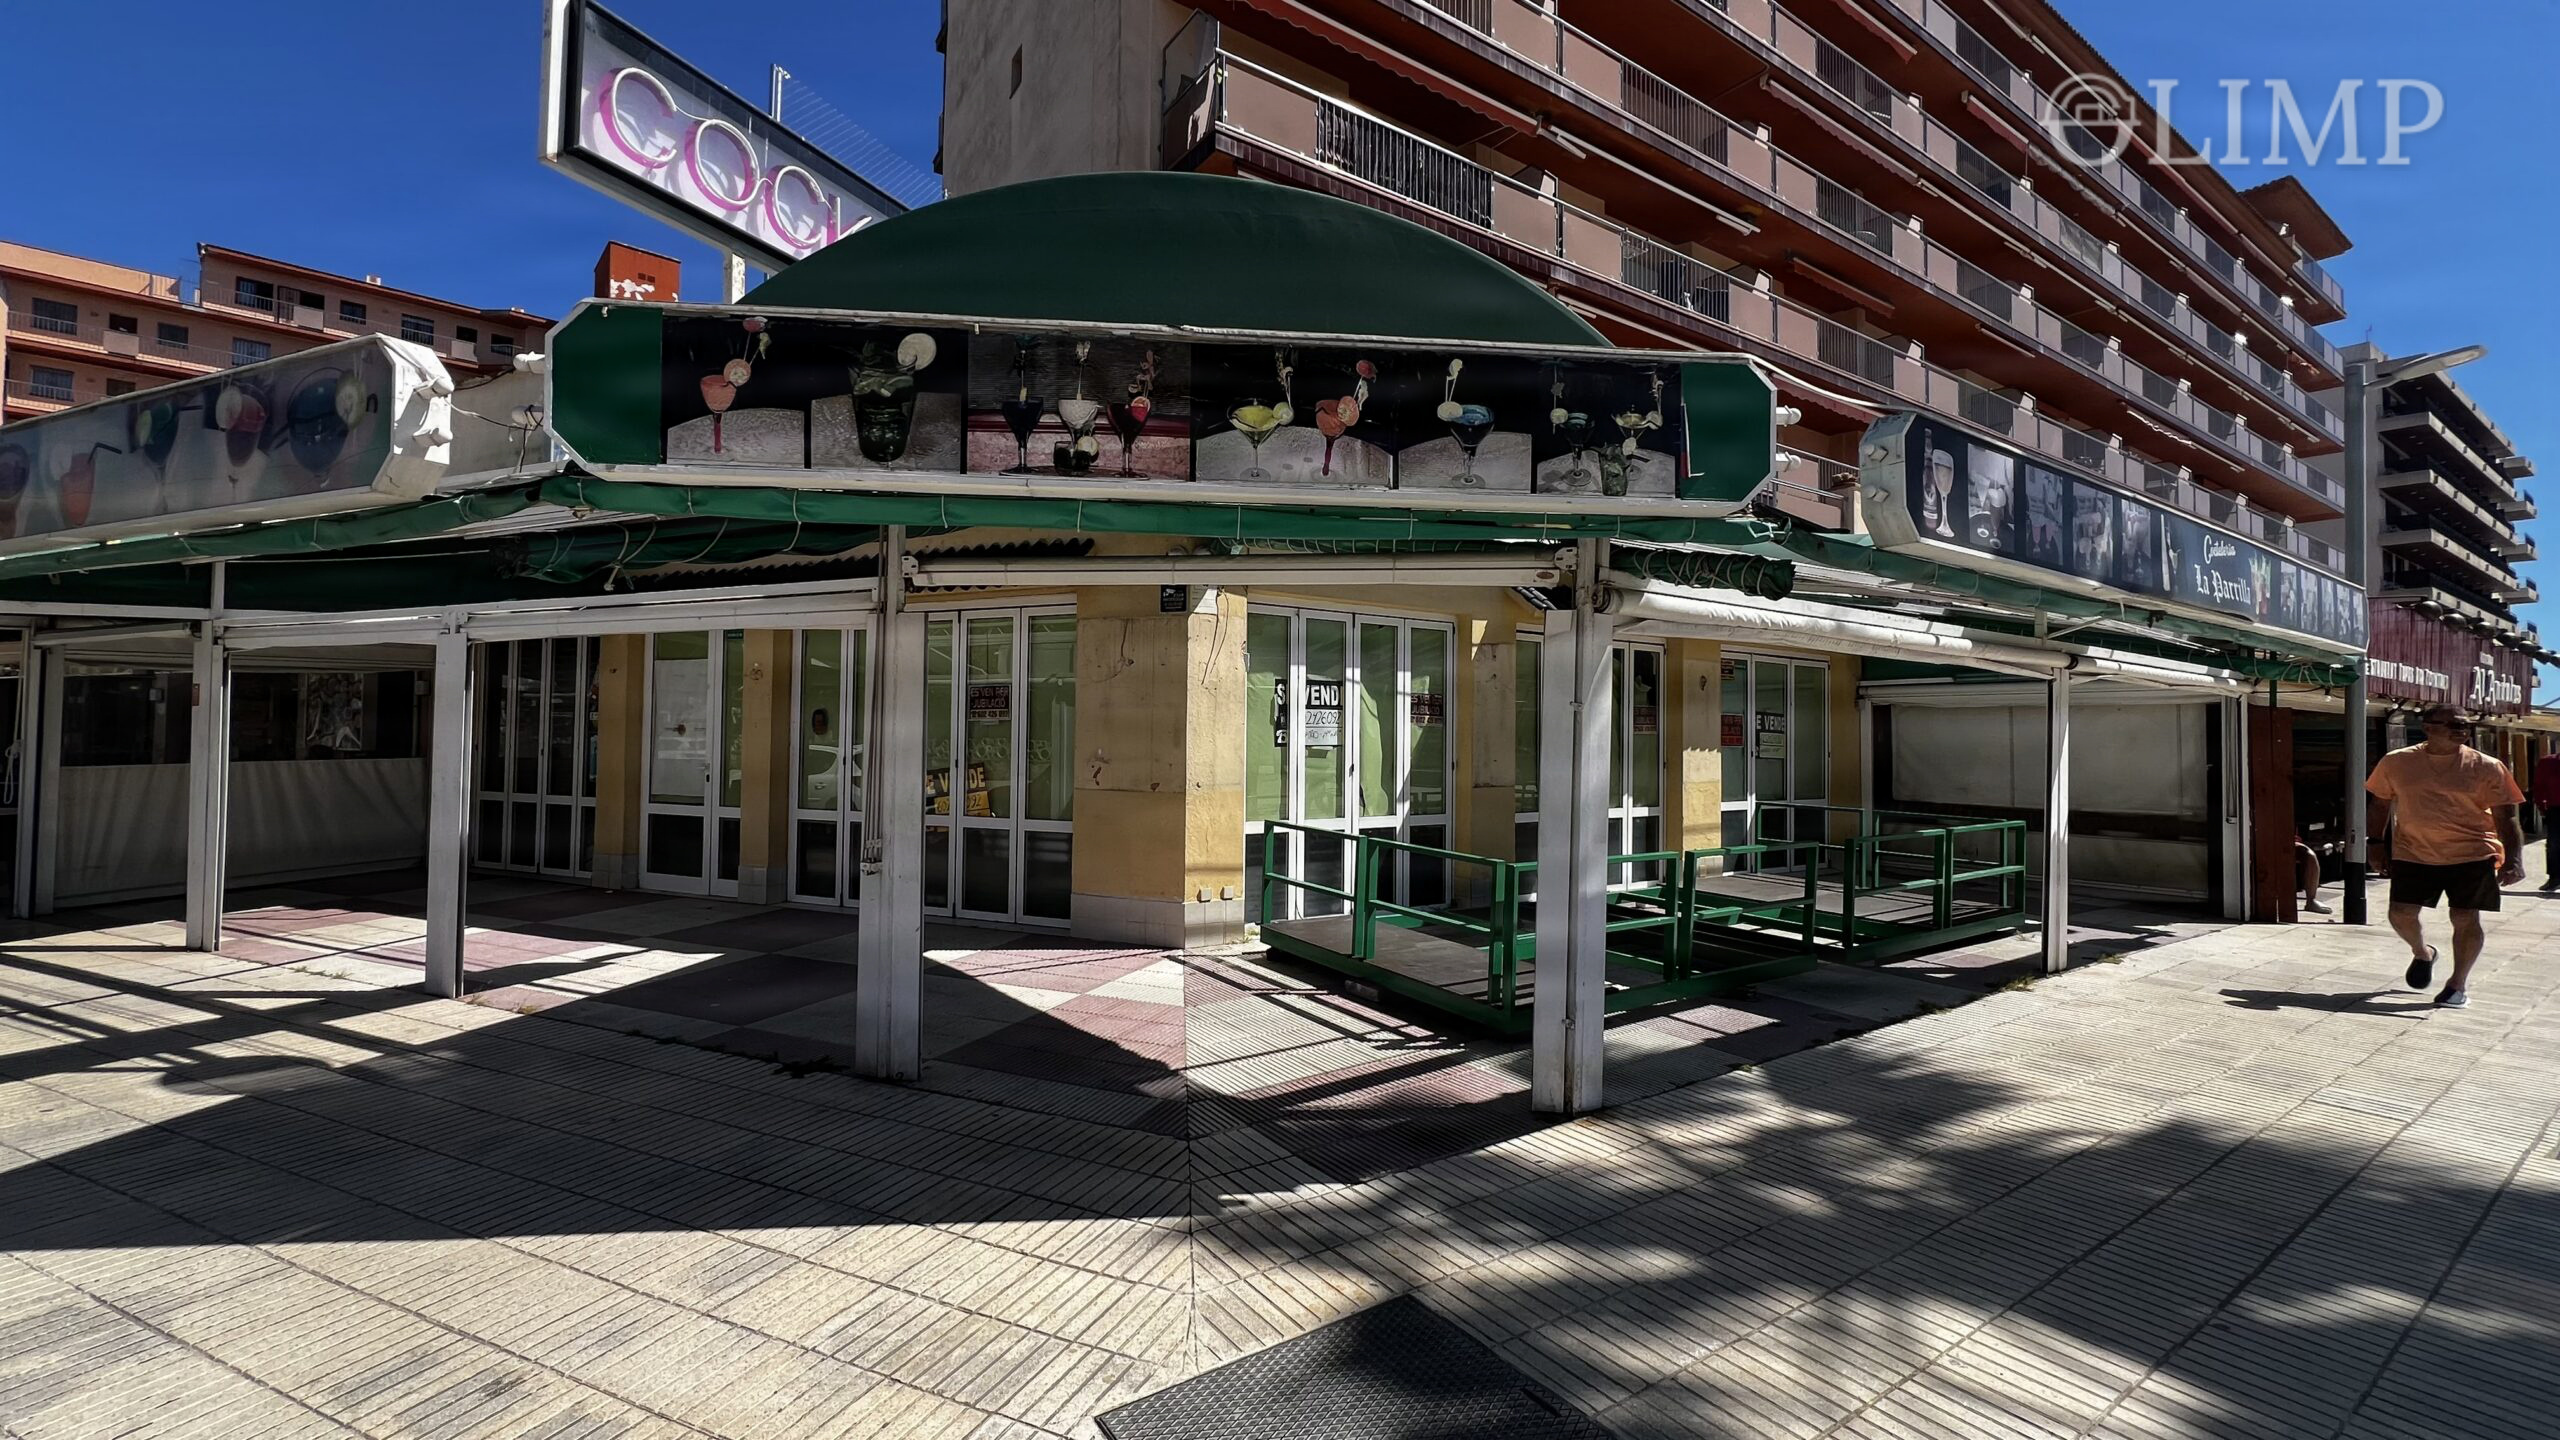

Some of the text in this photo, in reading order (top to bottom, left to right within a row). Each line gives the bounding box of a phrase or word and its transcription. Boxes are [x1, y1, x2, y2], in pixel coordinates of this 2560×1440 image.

[2194, 564, 2251, 605] La Parrilla
[1305, 685, 1343, 706] VEND
